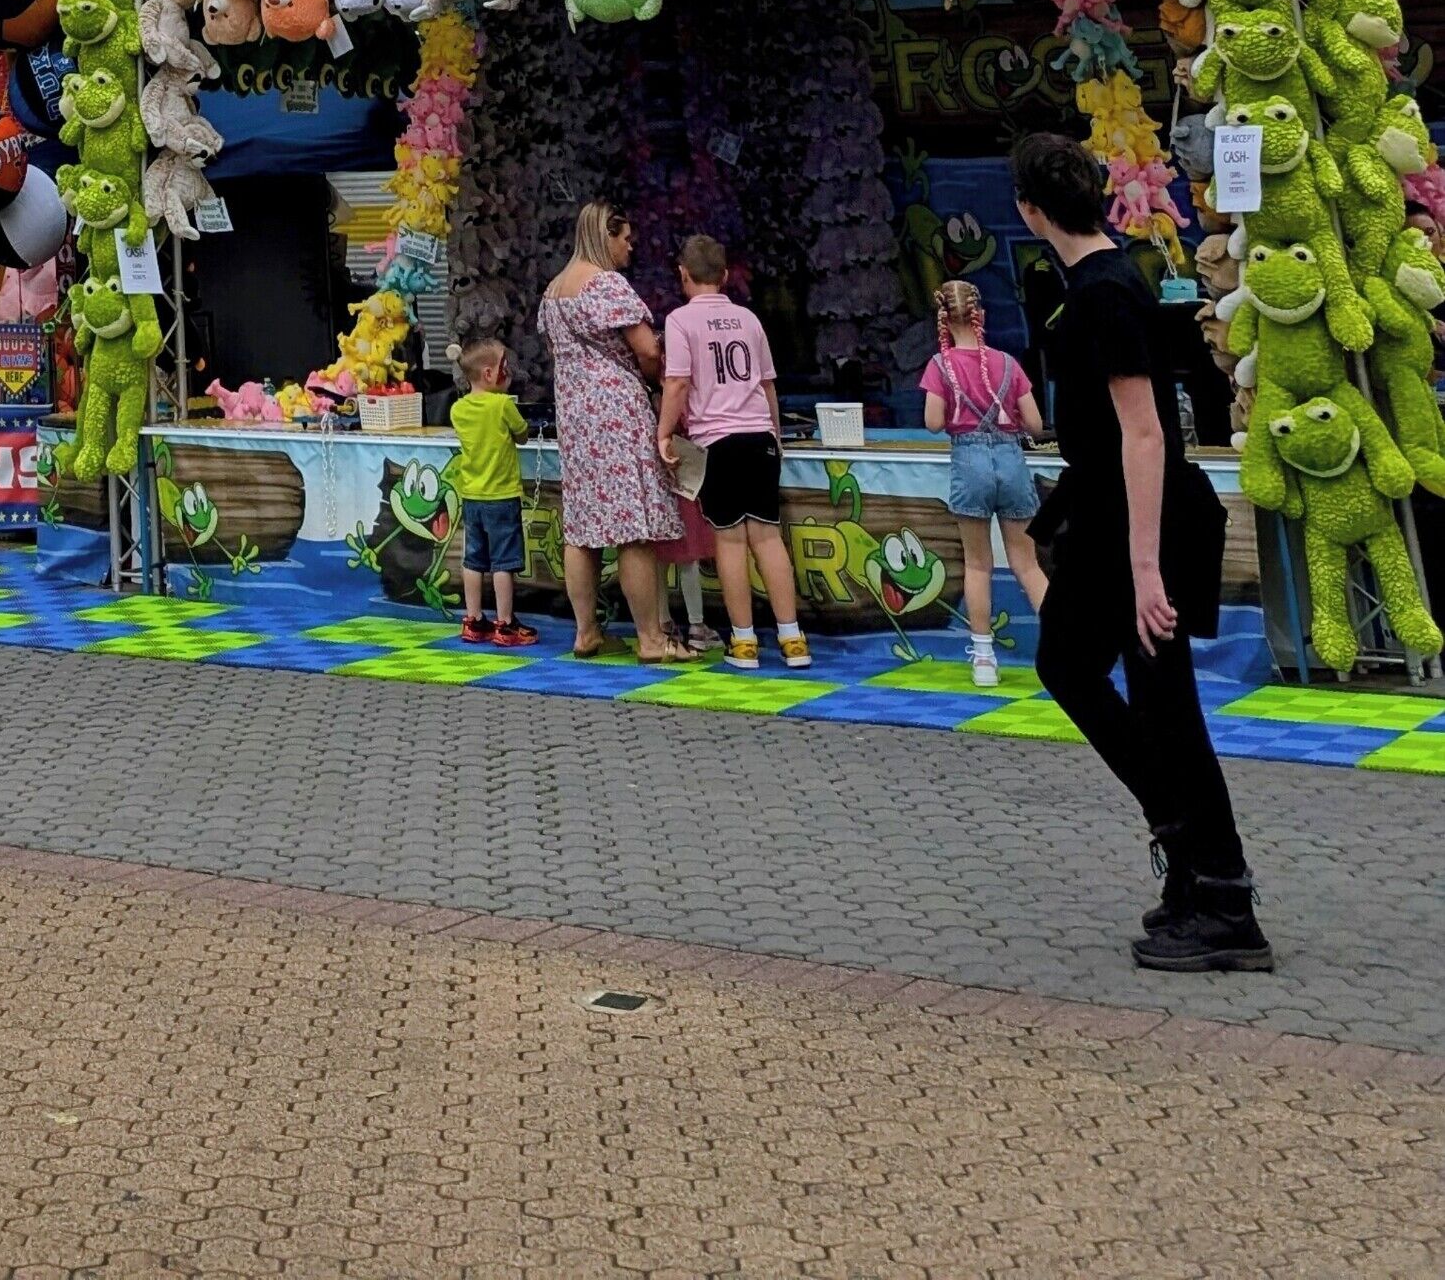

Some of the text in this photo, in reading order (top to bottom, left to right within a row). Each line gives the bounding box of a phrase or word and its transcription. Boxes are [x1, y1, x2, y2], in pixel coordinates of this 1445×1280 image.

[707, 319, 742, 331] MESSI
[707, 340, 751, 385] 10
[4, 371, 25, 384] HERE
